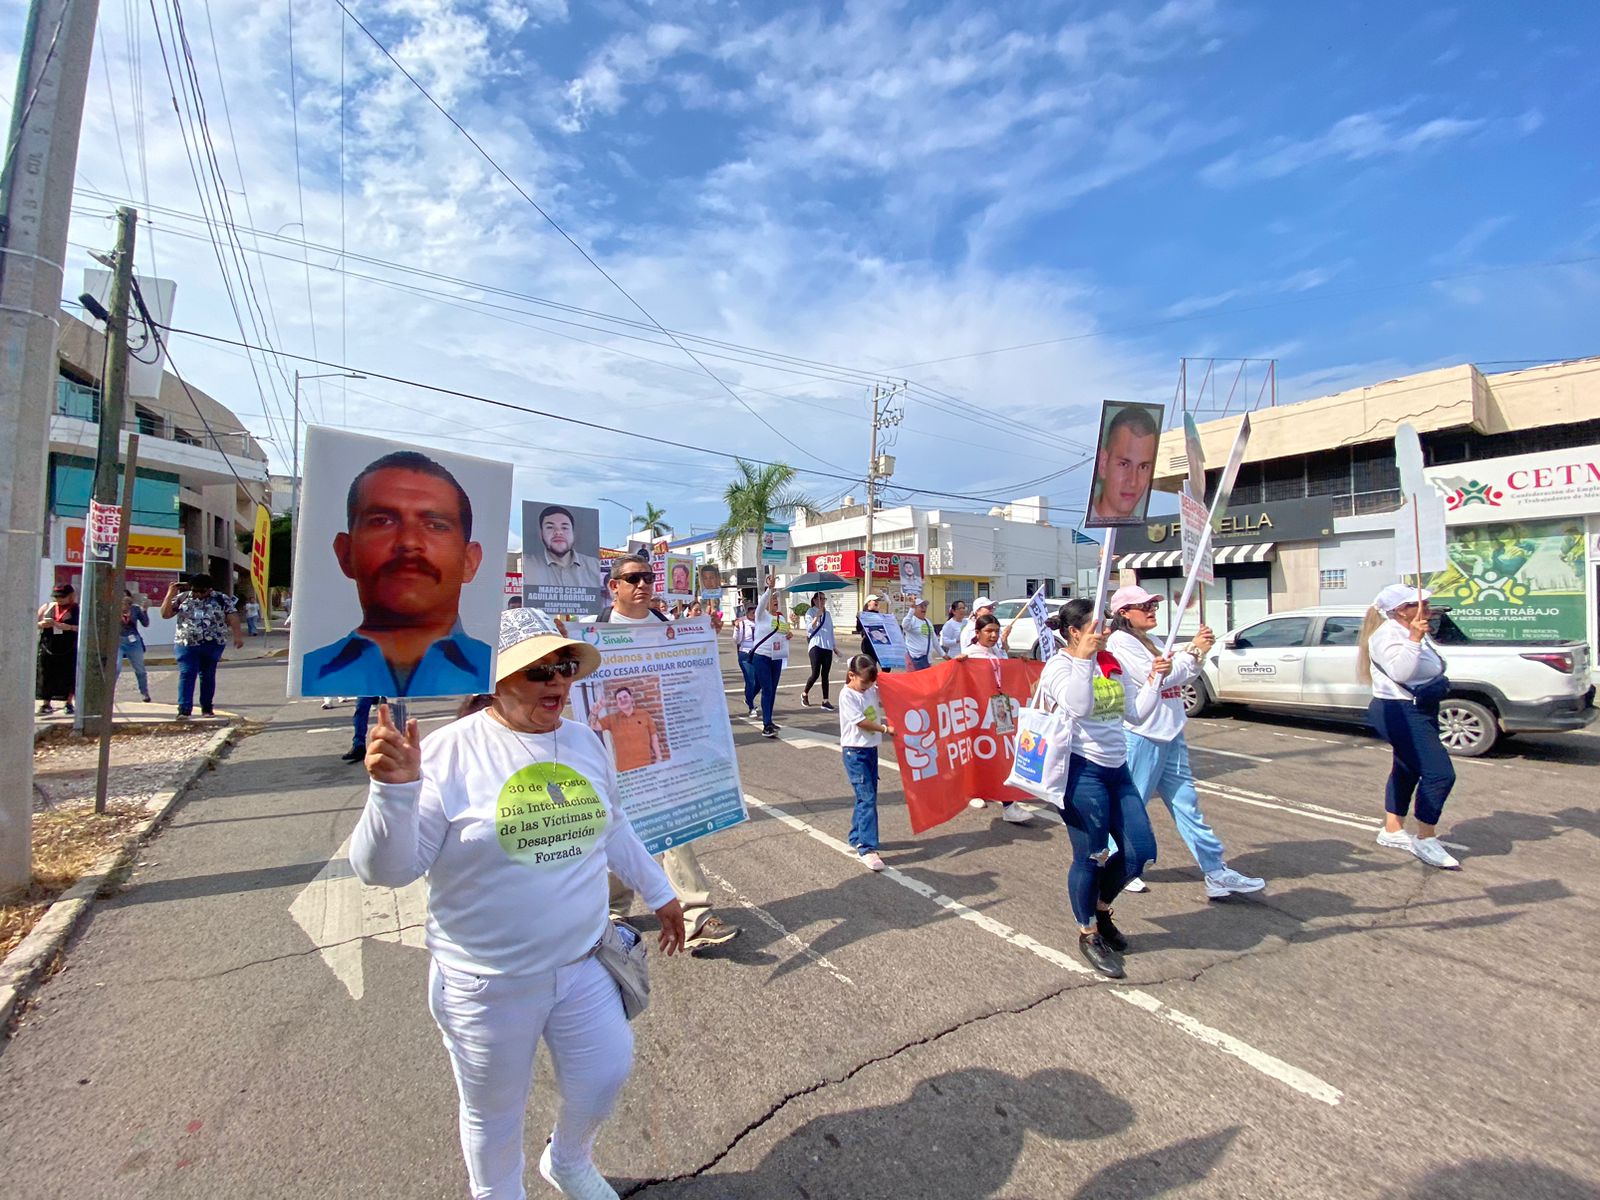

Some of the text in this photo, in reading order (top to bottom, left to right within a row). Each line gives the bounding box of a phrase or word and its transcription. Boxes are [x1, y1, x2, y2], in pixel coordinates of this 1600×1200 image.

[1171, 513, 1272, 537] FELLA
[128, 545, 174, 557] DHL
[538, 586, 563, 594] MARCO
[562, 594, 596, 602] RODRIGUEZ
[1484, 608, 1500, 616] DE
[1503, 607, 1559, 616] TRABAJO
[602, 635, 634, 645] Sinaloa
[584, 657, 714, 680] ARCO CESAR AGUILAR RODRIGUEZ
[947, 735, 997, 769] PERO
[1003, 735, 1016, 759] N
[509, 779, 587, 793] 30 de gosto
[501, 795, 600, 818] Día Internacional
[500, 808, 606, 836] de las Víctimas de
[516, 826, 595, 849] Desaparición
[535, 845, 582, 864] Forzada
